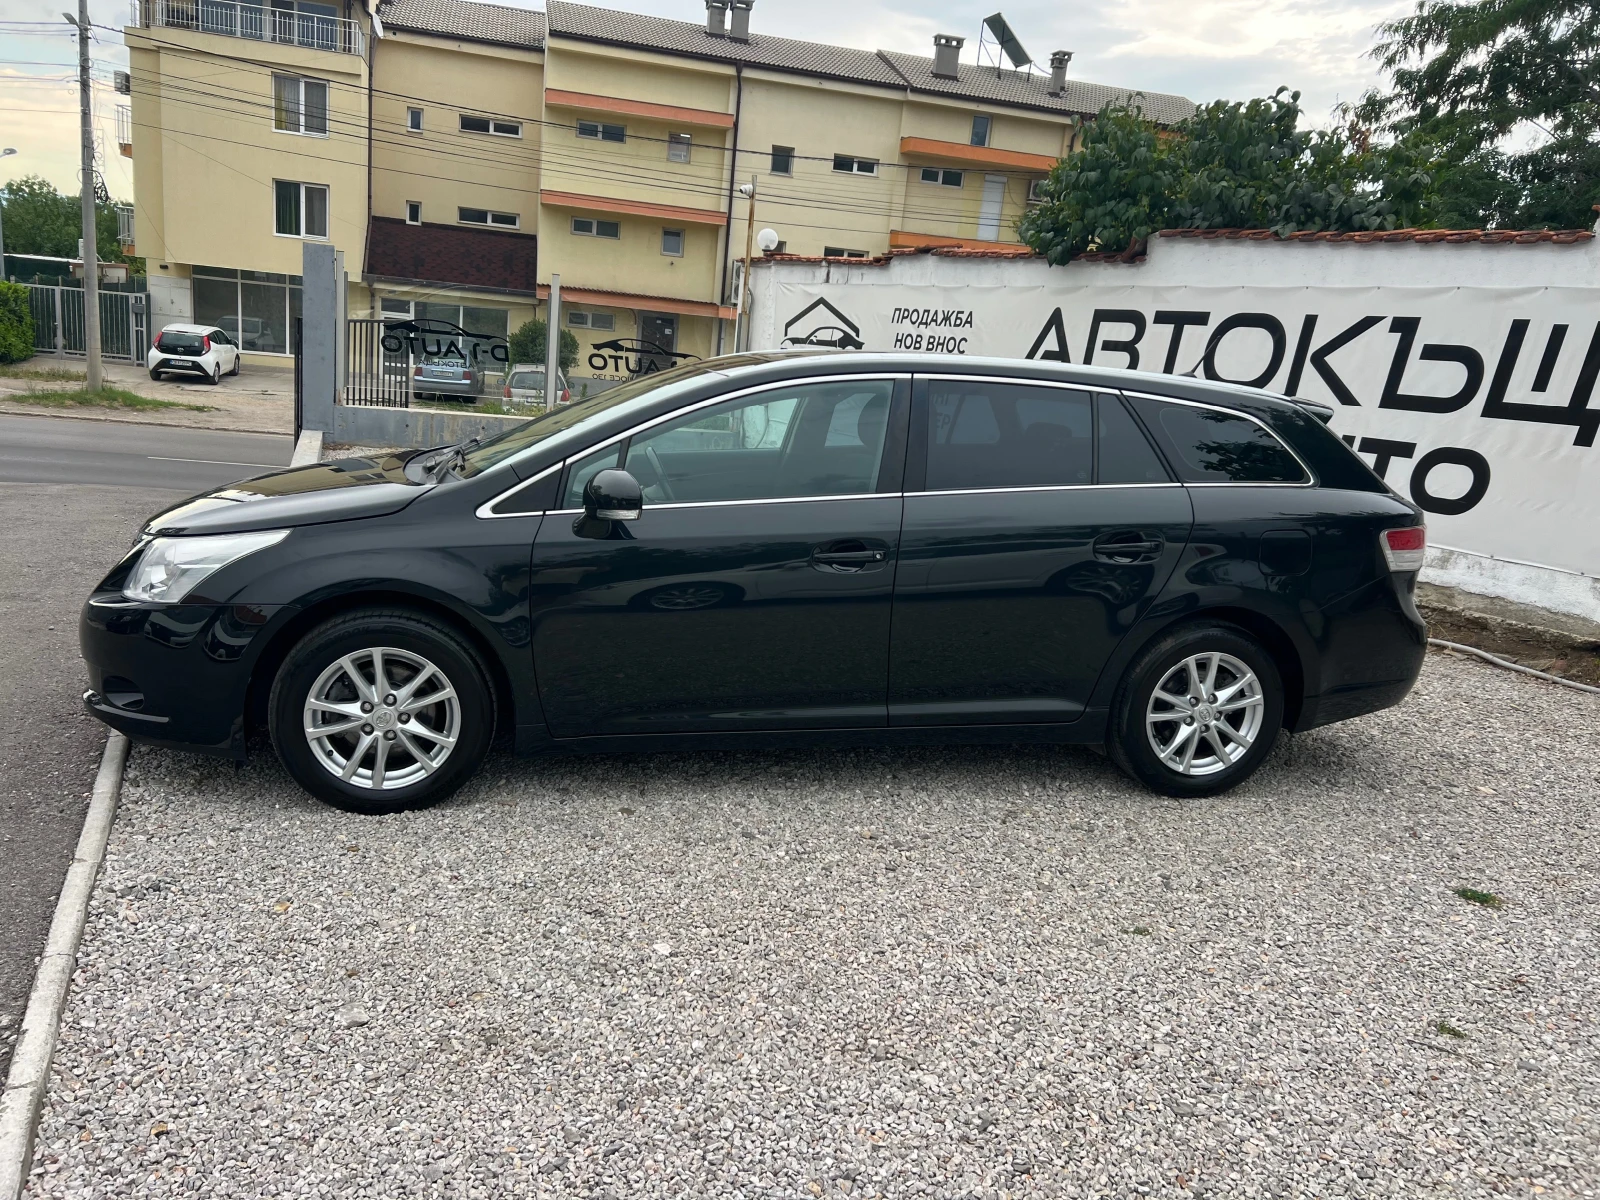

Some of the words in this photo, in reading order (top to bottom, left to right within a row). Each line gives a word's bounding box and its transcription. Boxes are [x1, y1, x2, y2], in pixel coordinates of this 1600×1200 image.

[891, 307, 973, 329] ПРОДАЖБА
[894, 332, 923, 350] НОВ
[925, 335, 968, 354] ВНОС
